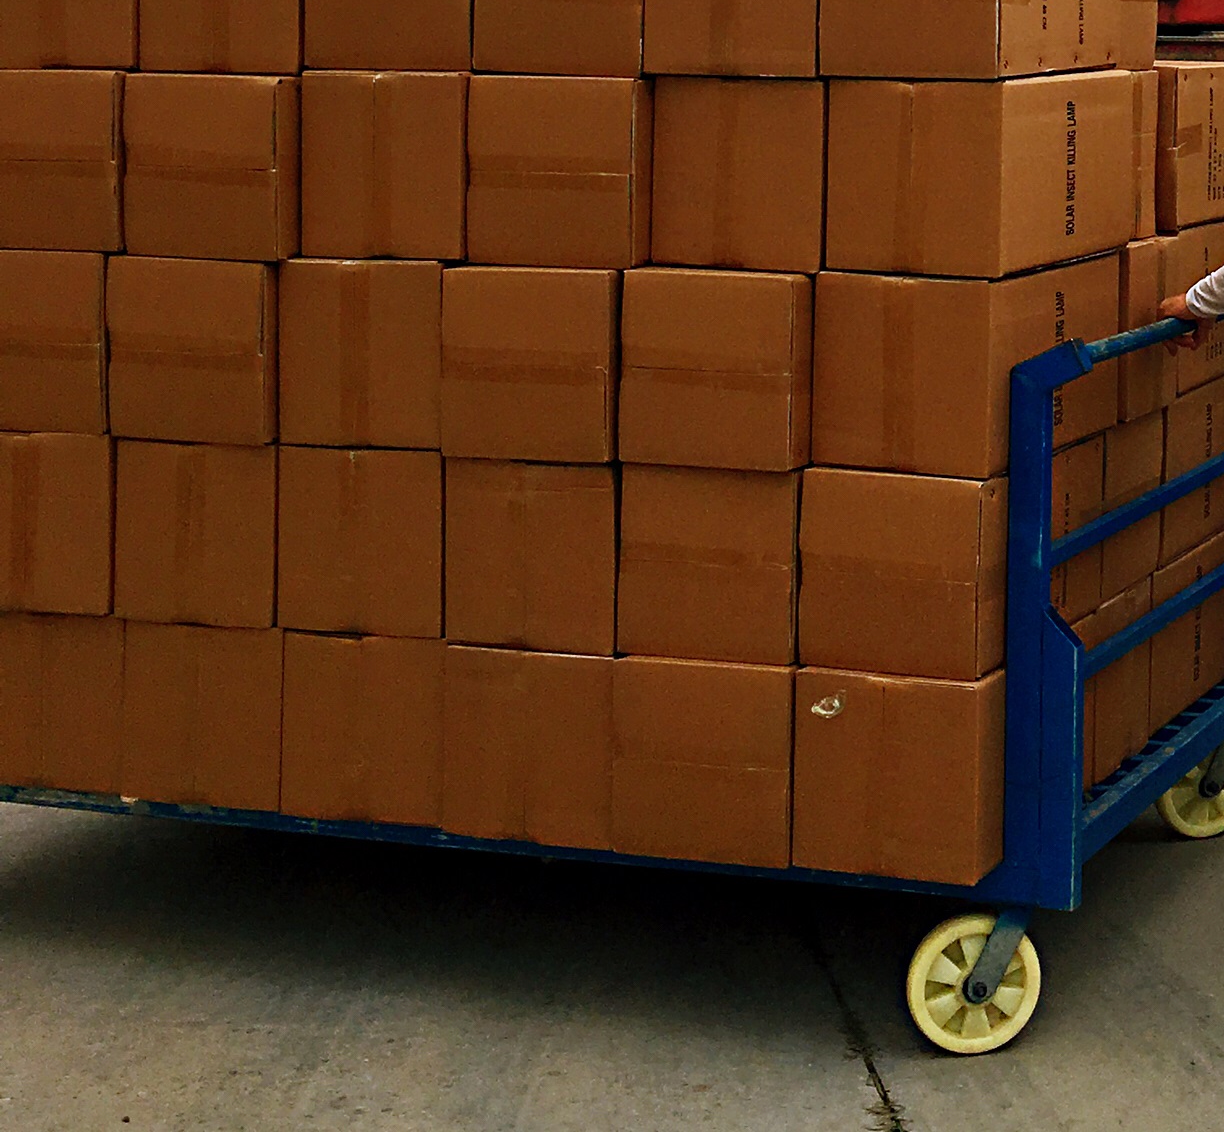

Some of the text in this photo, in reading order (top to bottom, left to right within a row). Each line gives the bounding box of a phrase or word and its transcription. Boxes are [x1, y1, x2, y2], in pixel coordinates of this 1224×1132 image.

[1065, 100, 1077, 236] SOLAR INSECT KILLING LAMP
[1056, 291, 1065, 318] LAMP
[1053, 393, 1064, 426] SOLAR
[1205, 403, 1213, 426] LAMP
